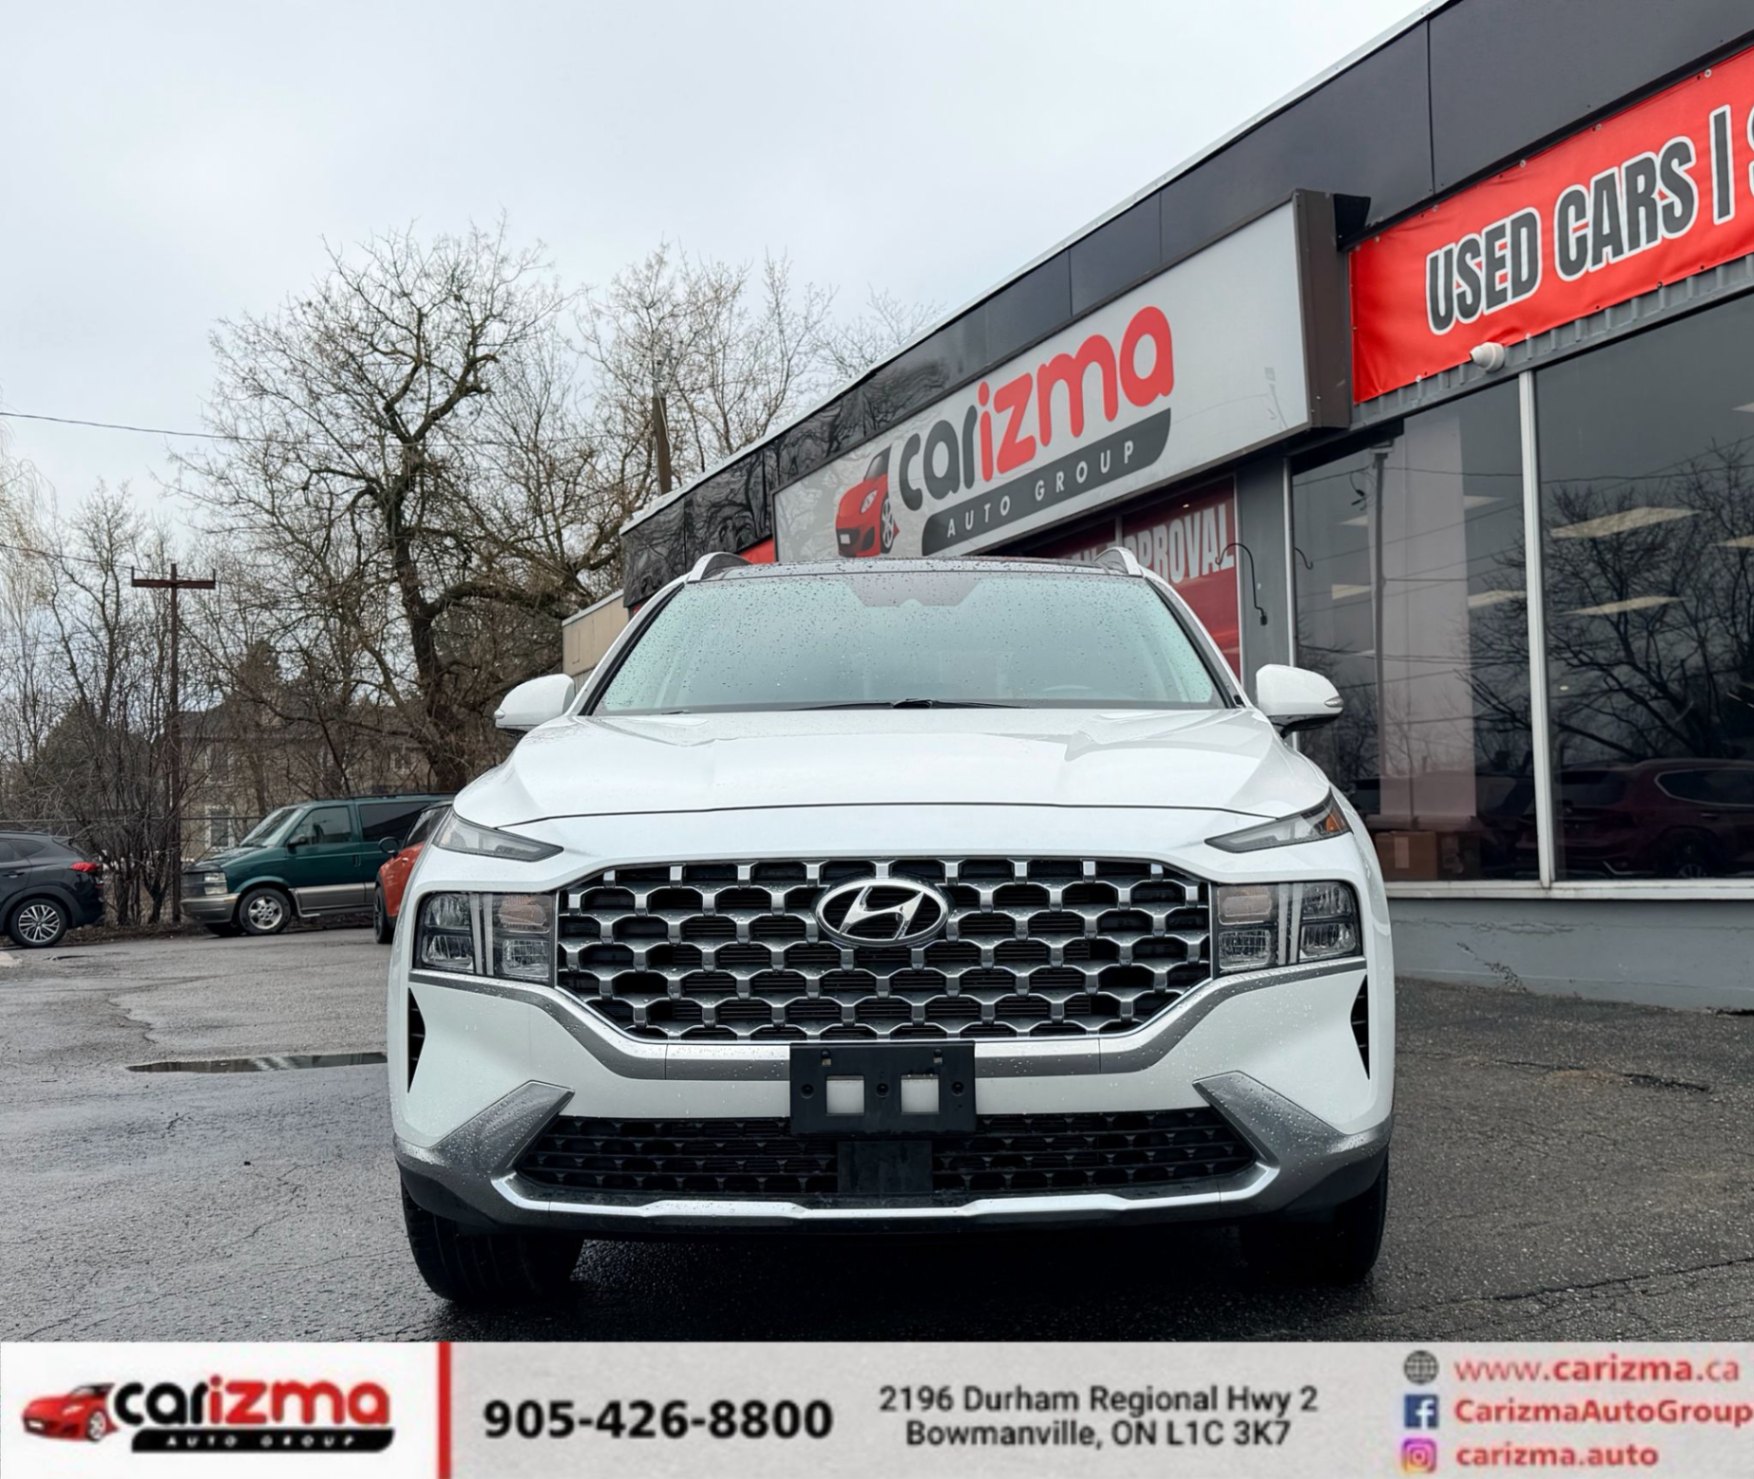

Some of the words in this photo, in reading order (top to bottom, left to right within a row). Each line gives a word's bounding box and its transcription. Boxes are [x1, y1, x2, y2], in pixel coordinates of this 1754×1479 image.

[1426, 207, 1542, 335] USED
[1554, 136, 1699, 281] CARS
[899, 306, 1175, 511] carizma
[946, 498, 1011, 538] AUTO
[1034, 440, 1134, 501] GROUP
[1107, 503, 1235, 584] PROVAL
